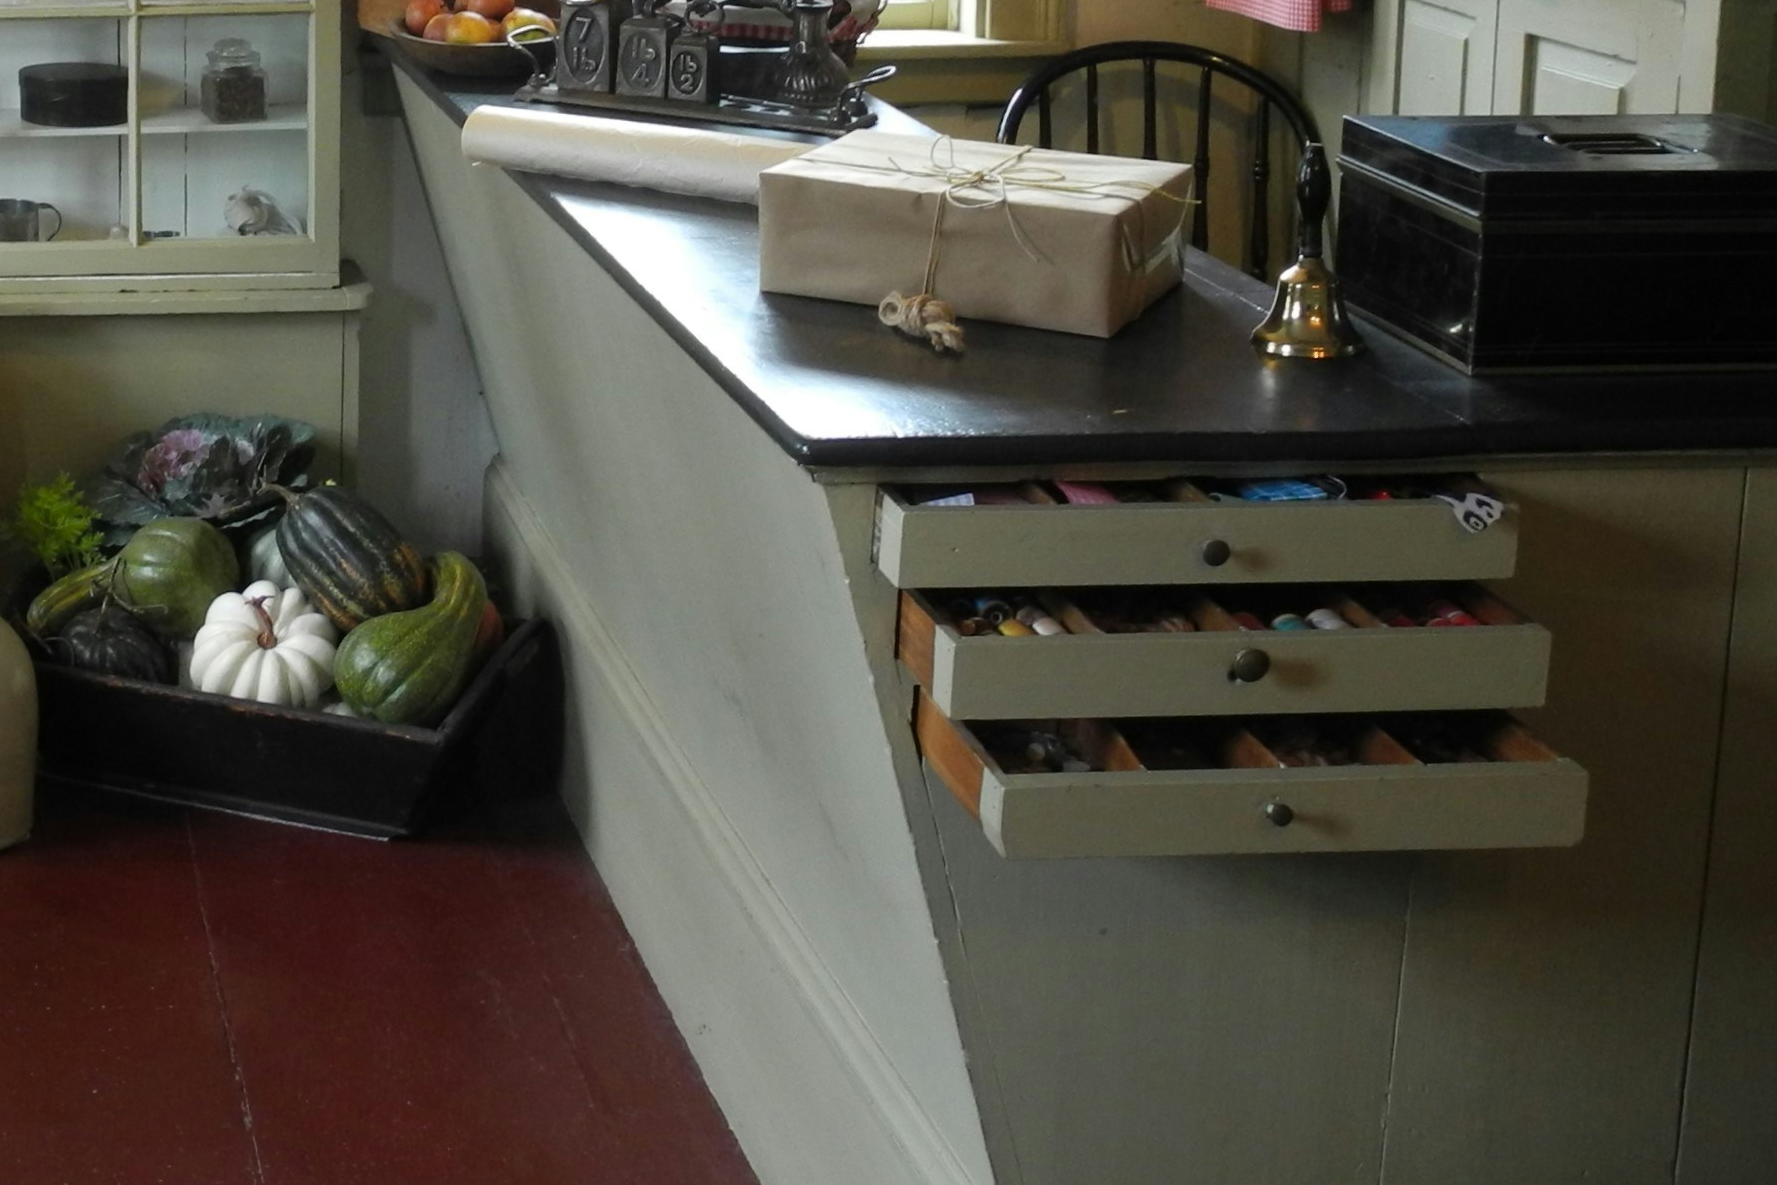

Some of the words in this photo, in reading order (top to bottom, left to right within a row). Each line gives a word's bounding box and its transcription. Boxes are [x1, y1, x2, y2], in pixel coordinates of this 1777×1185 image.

[575, 16, 593, 42] 7
[572, 46, 597, 71] lb
[631, 36, 657, 62] lb
[631, 63, 651, 84] 4
[679, 53, 698, 73] lb
[679, 72, 695, 91] 2
